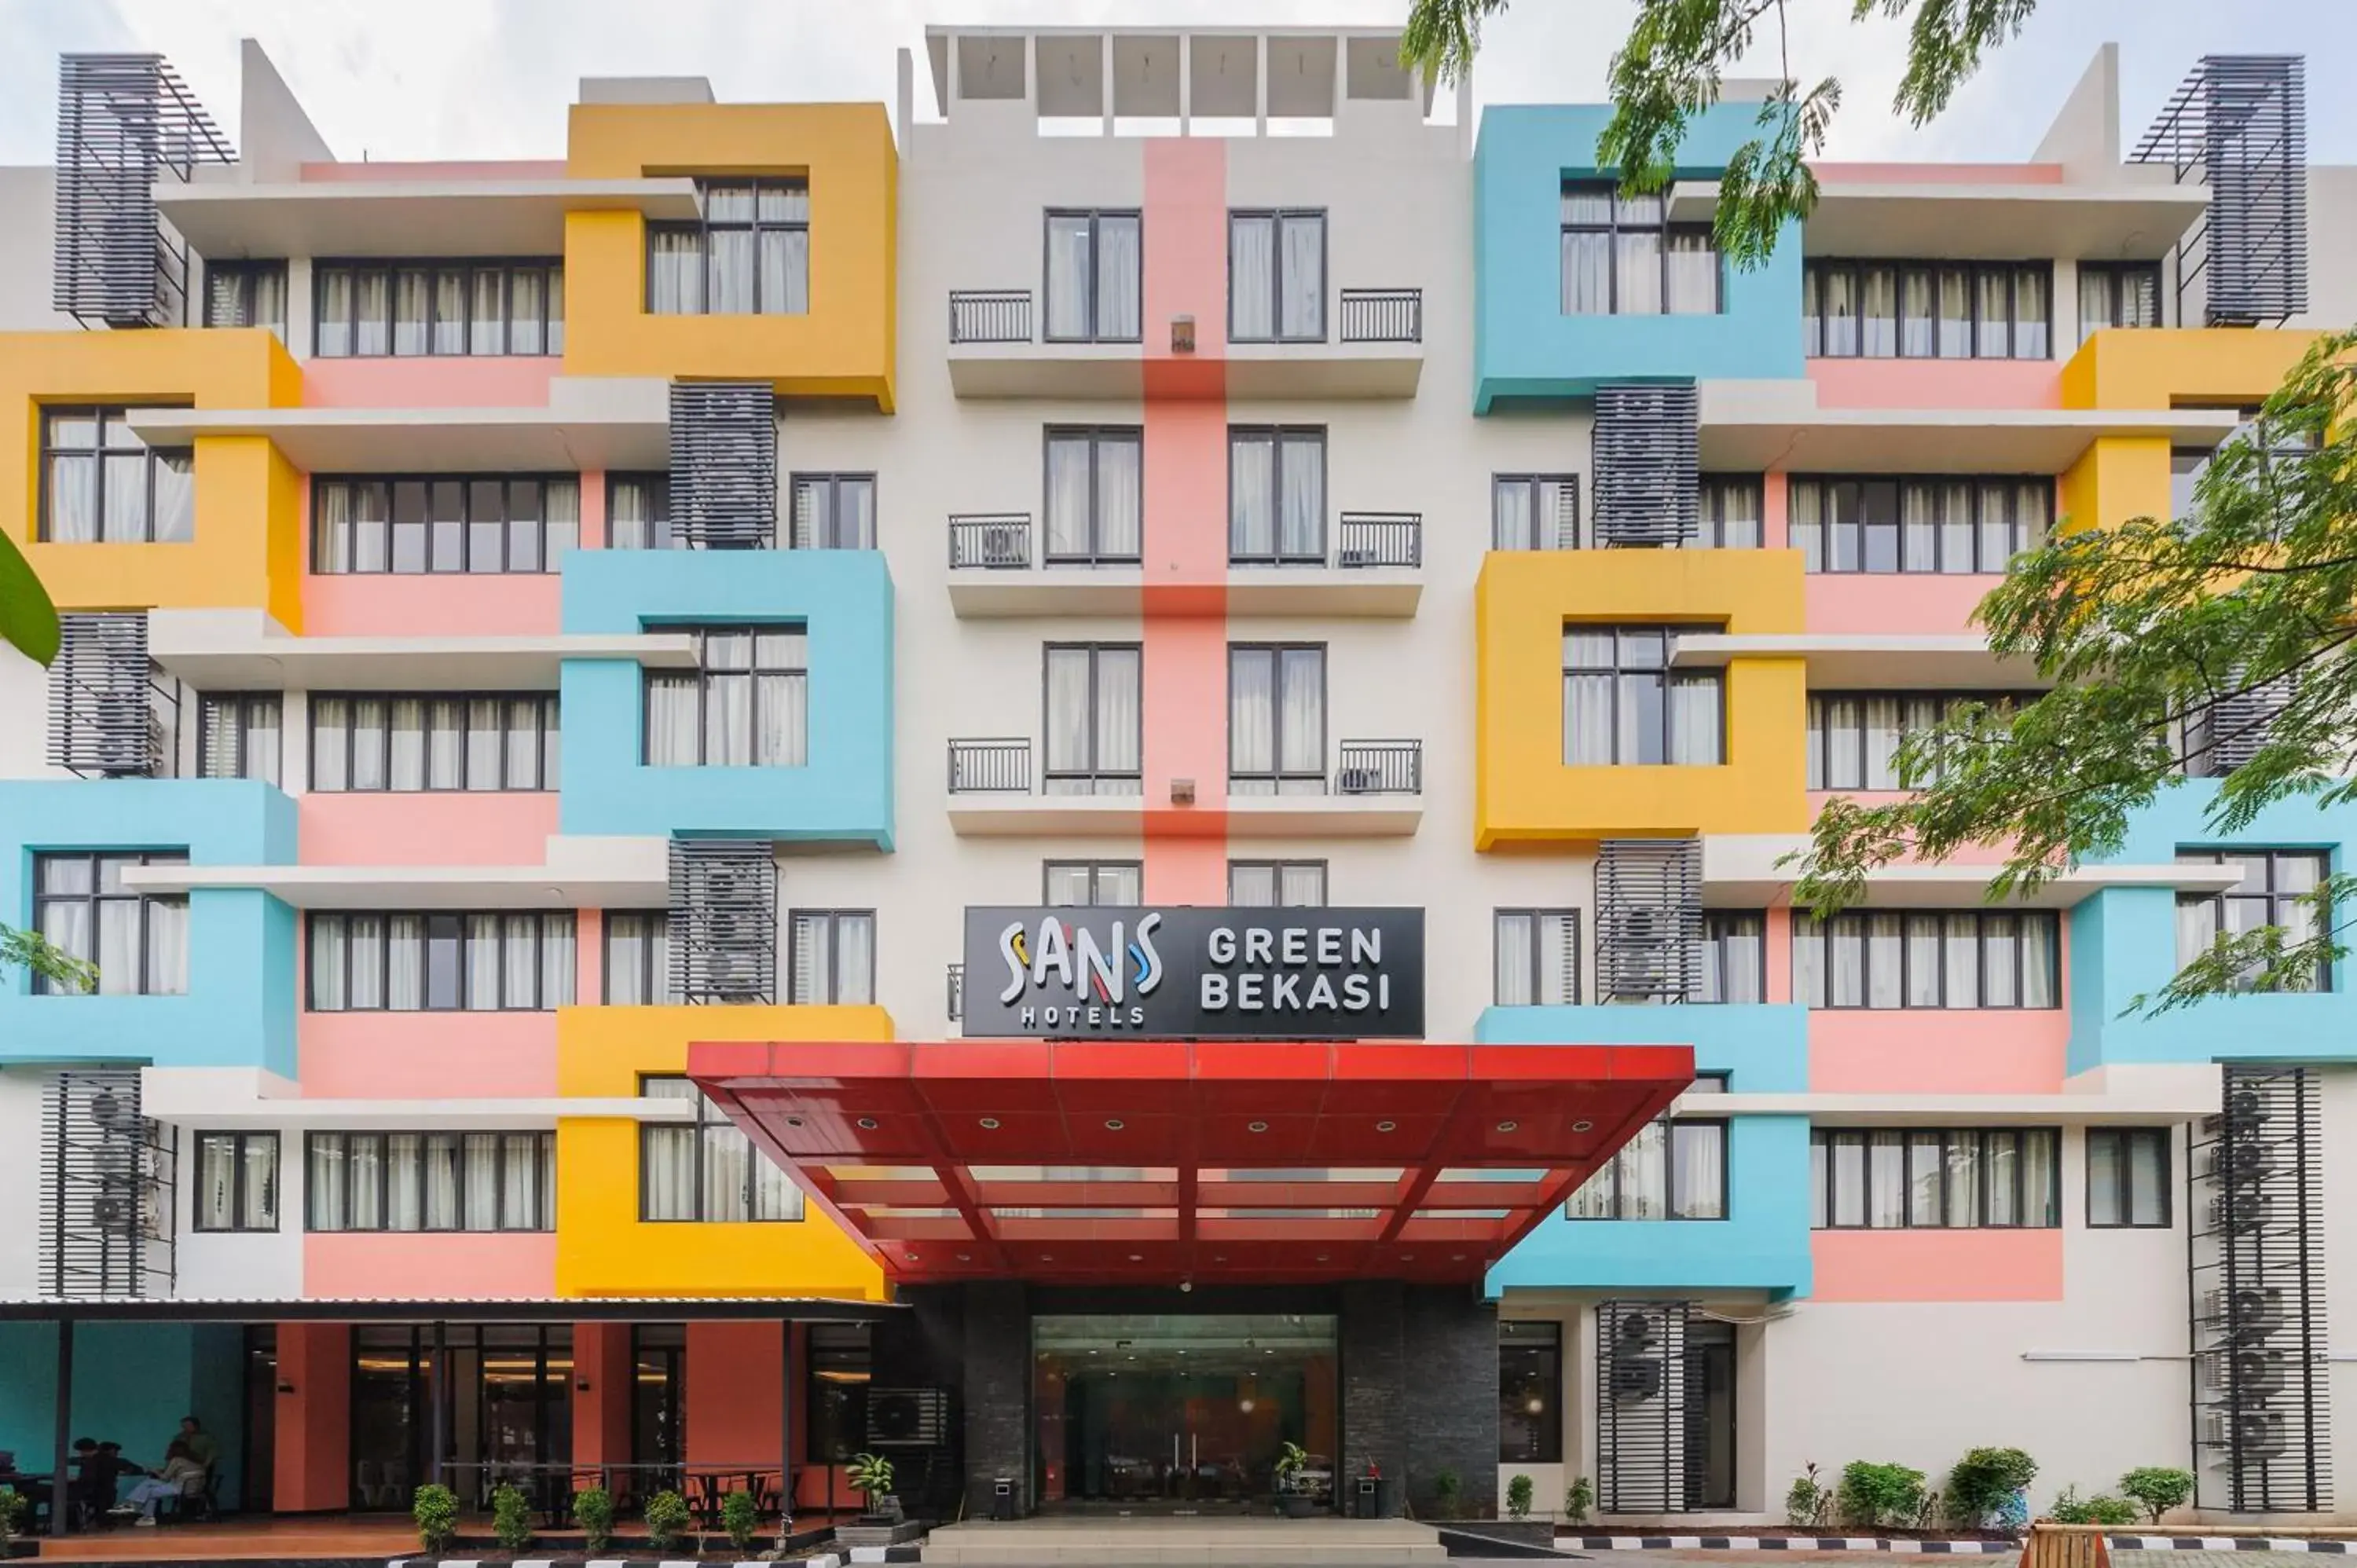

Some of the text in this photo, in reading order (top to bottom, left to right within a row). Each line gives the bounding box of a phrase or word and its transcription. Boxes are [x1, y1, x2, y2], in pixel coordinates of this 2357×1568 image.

[999, 912, 1163, 1004] SANS
[1208, 927, 1381, 964] GREEN
[1200, 973, 1390, 1011] BEKASI
[1021, 1006, 1145, 1025] HOTELS
